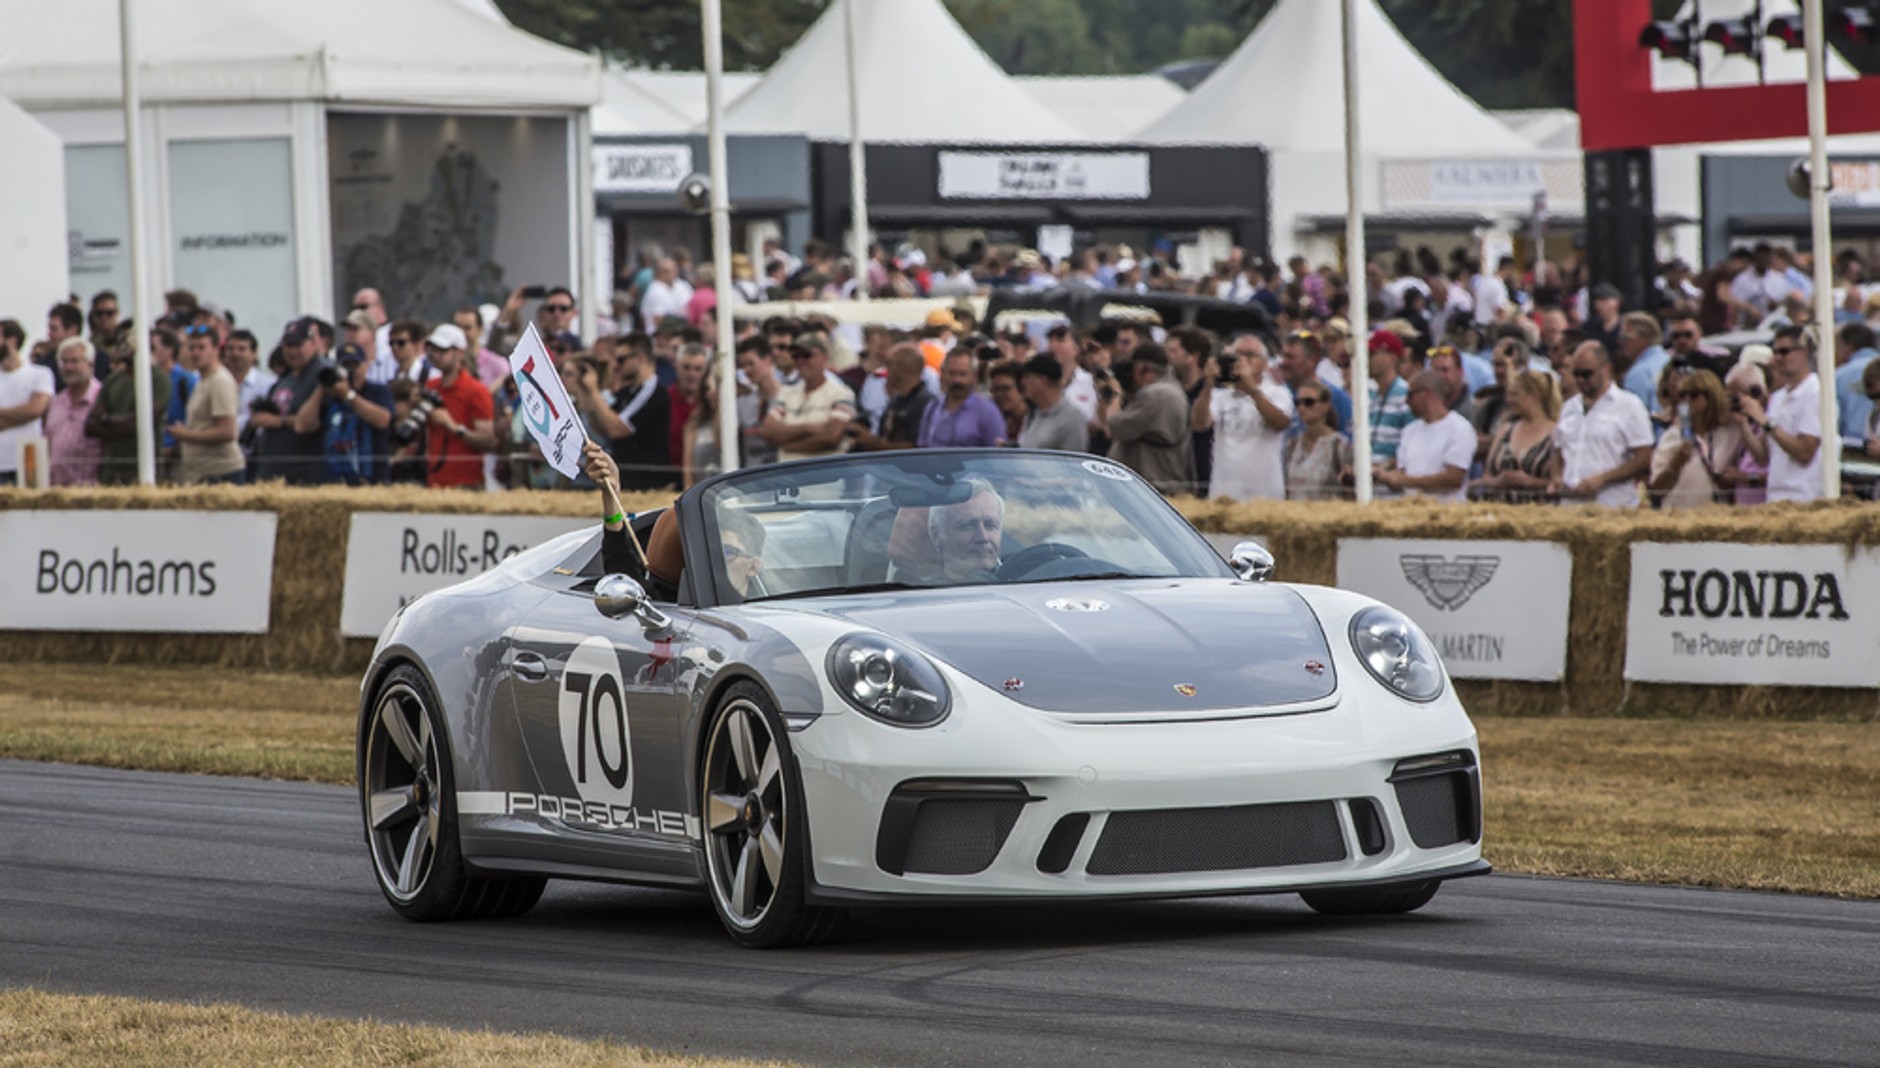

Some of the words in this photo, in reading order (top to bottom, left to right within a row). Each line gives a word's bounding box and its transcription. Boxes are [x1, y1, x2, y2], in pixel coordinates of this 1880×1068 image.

[181, 231, 288, 248] INFORMATION
[37, 546, 216, 597] Bonhams
[1658, 568, 1850, 621] HONDA
[1443, 632, 1505, 663] MARTIN
[1671, 631, 1697, 656] The
[1700, 632, 1745, 657] Power
[1749, 633, 1764, 658] of
[1767, 634, 1831, 660] Dreams
[565, 671, 629, 790] 70
[508, 791, 688, 837] PORSCHE
